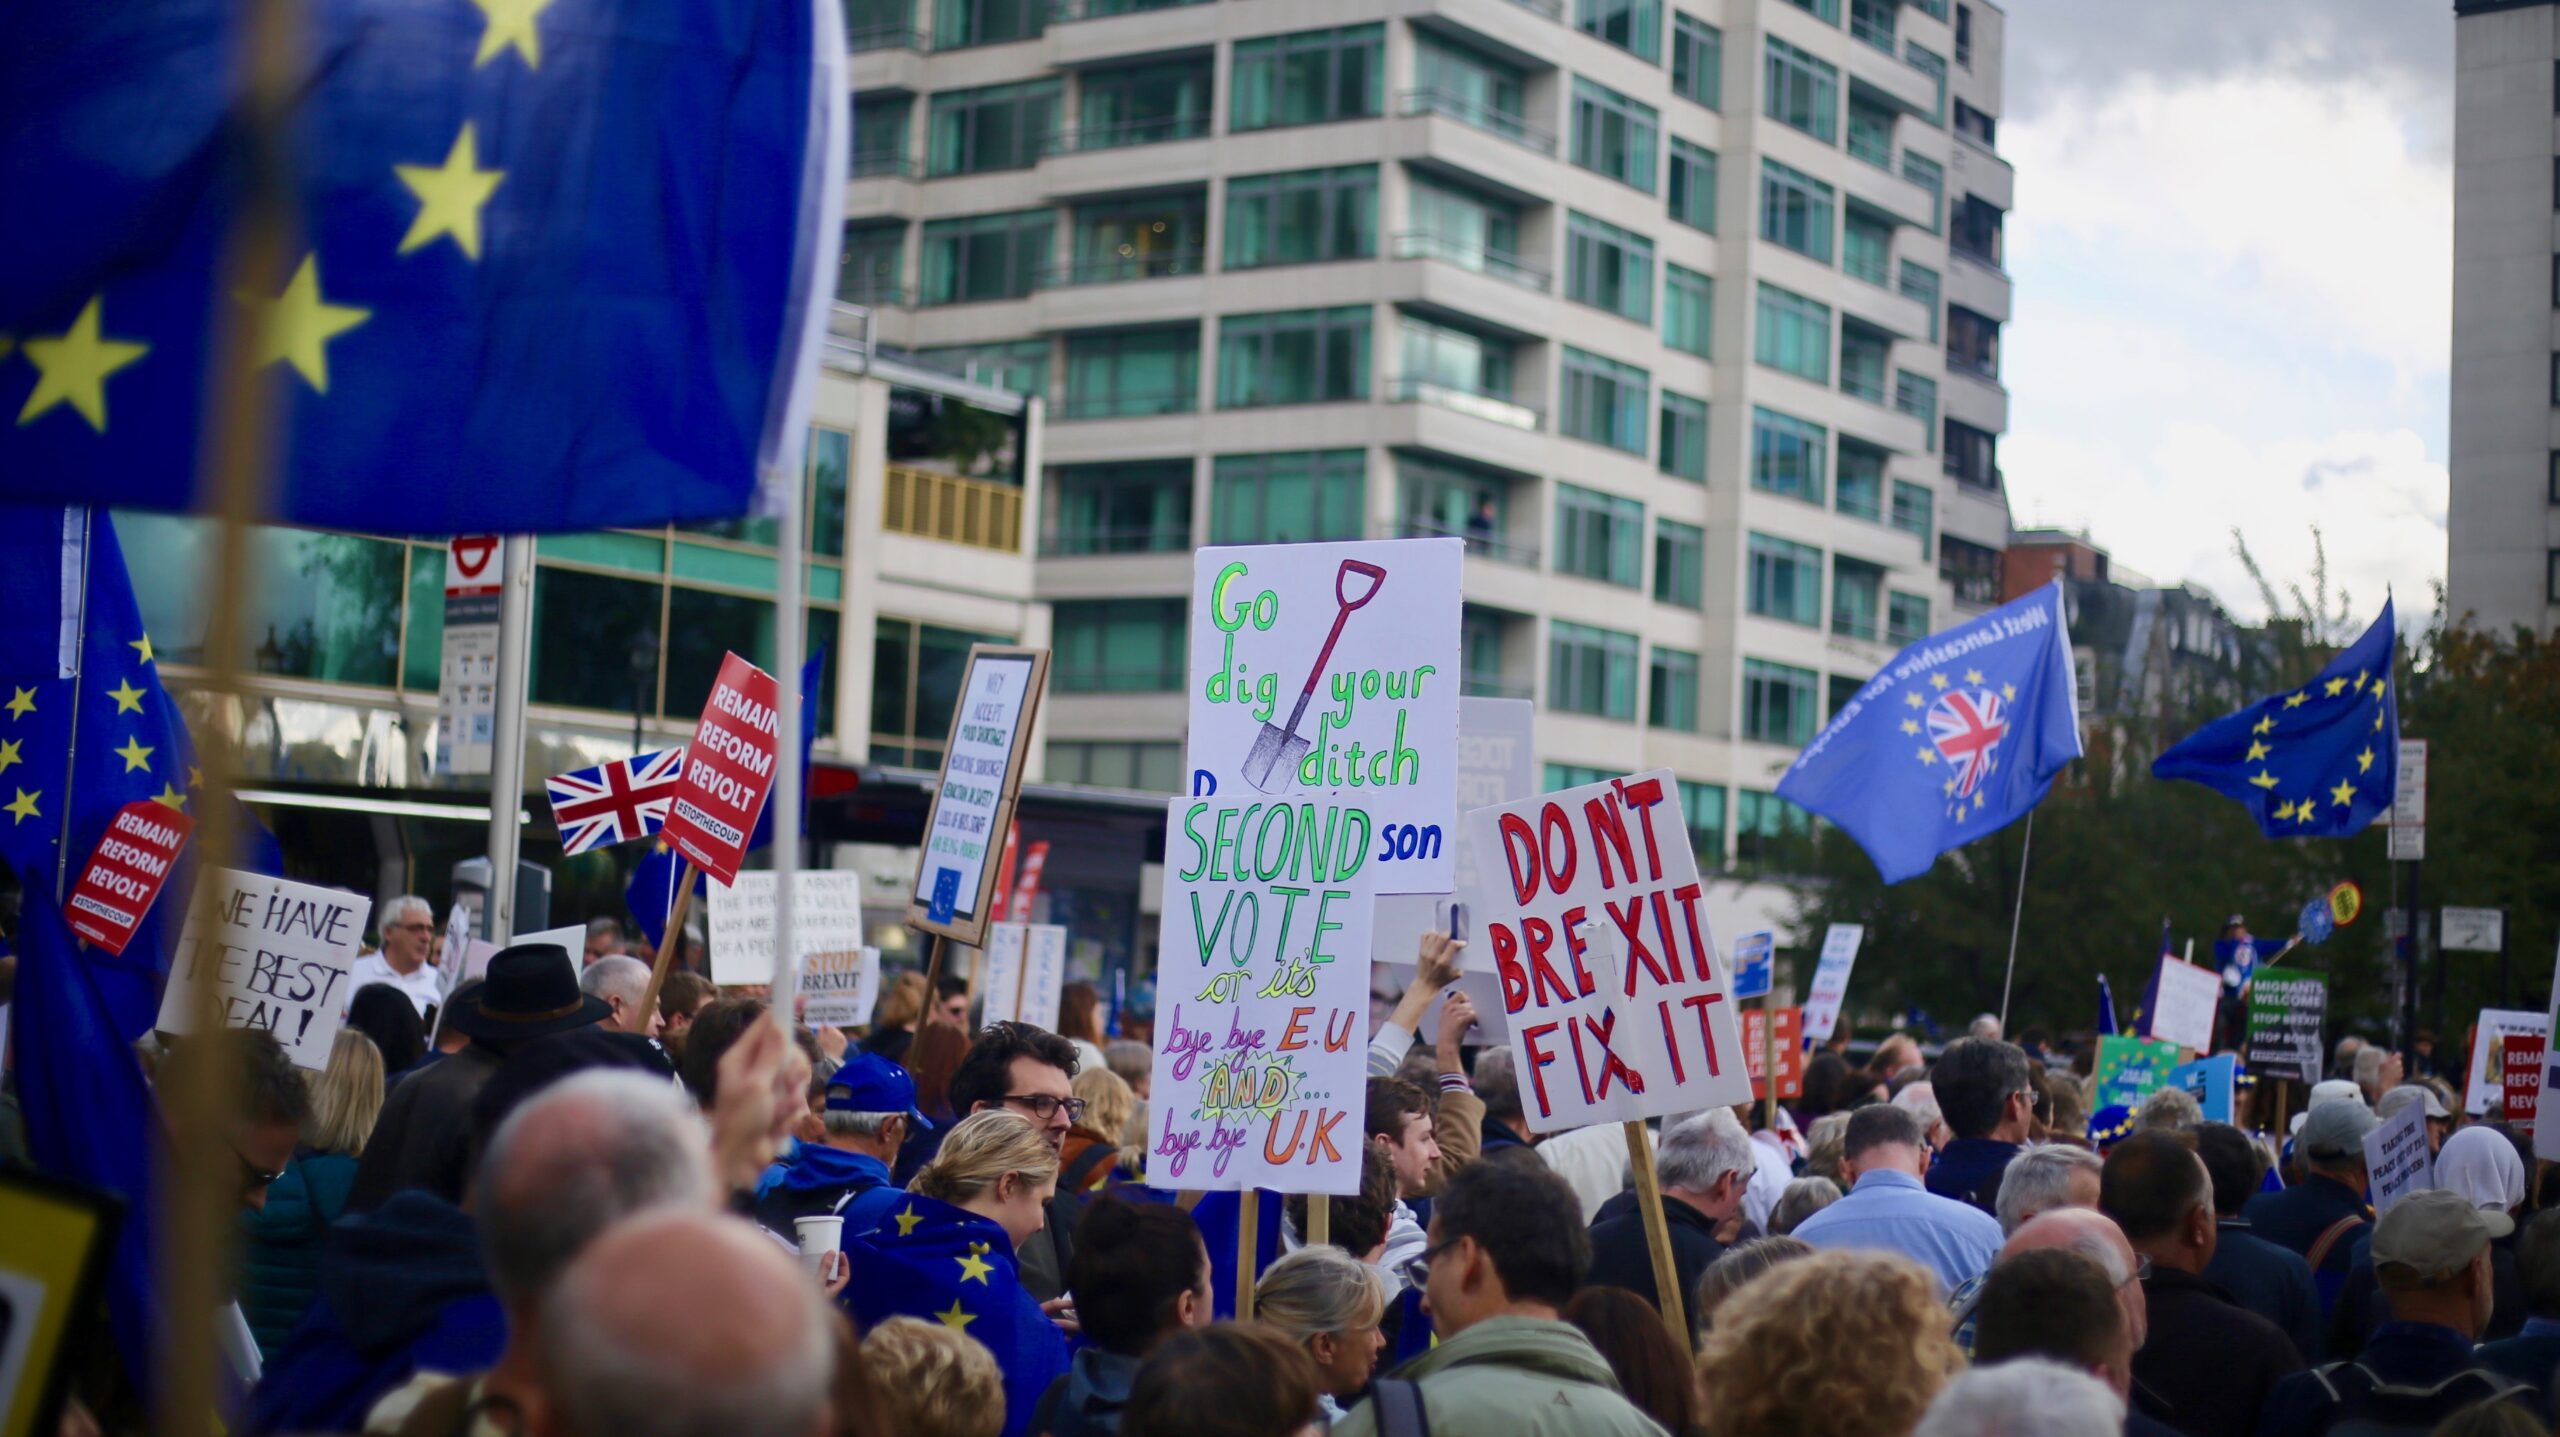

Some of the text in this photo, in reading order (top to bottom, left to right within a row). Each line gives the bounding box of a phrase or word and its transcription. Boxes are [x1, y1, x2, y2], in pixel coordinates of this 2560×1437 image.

[1211, 562, 1278, 632] Go
[1205, 633, 1436, 729] dig your
[714, 684, 781, 738] REMAIN
[698, 720, 773, 777] REFORM
[1298, 709, 1419, 787] ditch
[688, 759, 755, 812] REVOLT
[115, 812, 181, 850] REMAIN
[677, 801, 740, 844] #STOPTHECOUP
[1179, 802, 1372, 883] SECOND
[1498, 778, 1664, 906] DON'T
[87, 865, 150, 902] REVOLT
[98, 837, 168, 877] REFORM
[1190, 886, 1350, 967] VOTE
[1488, 883, 1713, 1014] BREXIT
[246, 949, 348, 1008] BEST
[802, 971, 861, 990] BREXIT
[808, 949, 858, 974] STOP
[1195, 947, 1322, 1004] or it's
[2254, 980, 2323, 992] MIGRANTS
[2253, 1013, 2281, 1024] STOP
[2255, 992, 2321, 1007] WELCOME
[1161, 1004, 1356, 1081] bye bye E.U
[1522, 993, 1724, 1118] FIX IT
[2253, 1031, 2281, 1044] STOP
[2507, 1051, 2544, 1065] REMA
[2506, 1073, 2540, 1087] REFO
[1155, 1107, 1347, 1178] bye bye U.K
[2373, 1158, 2396, 1180] PEACE
